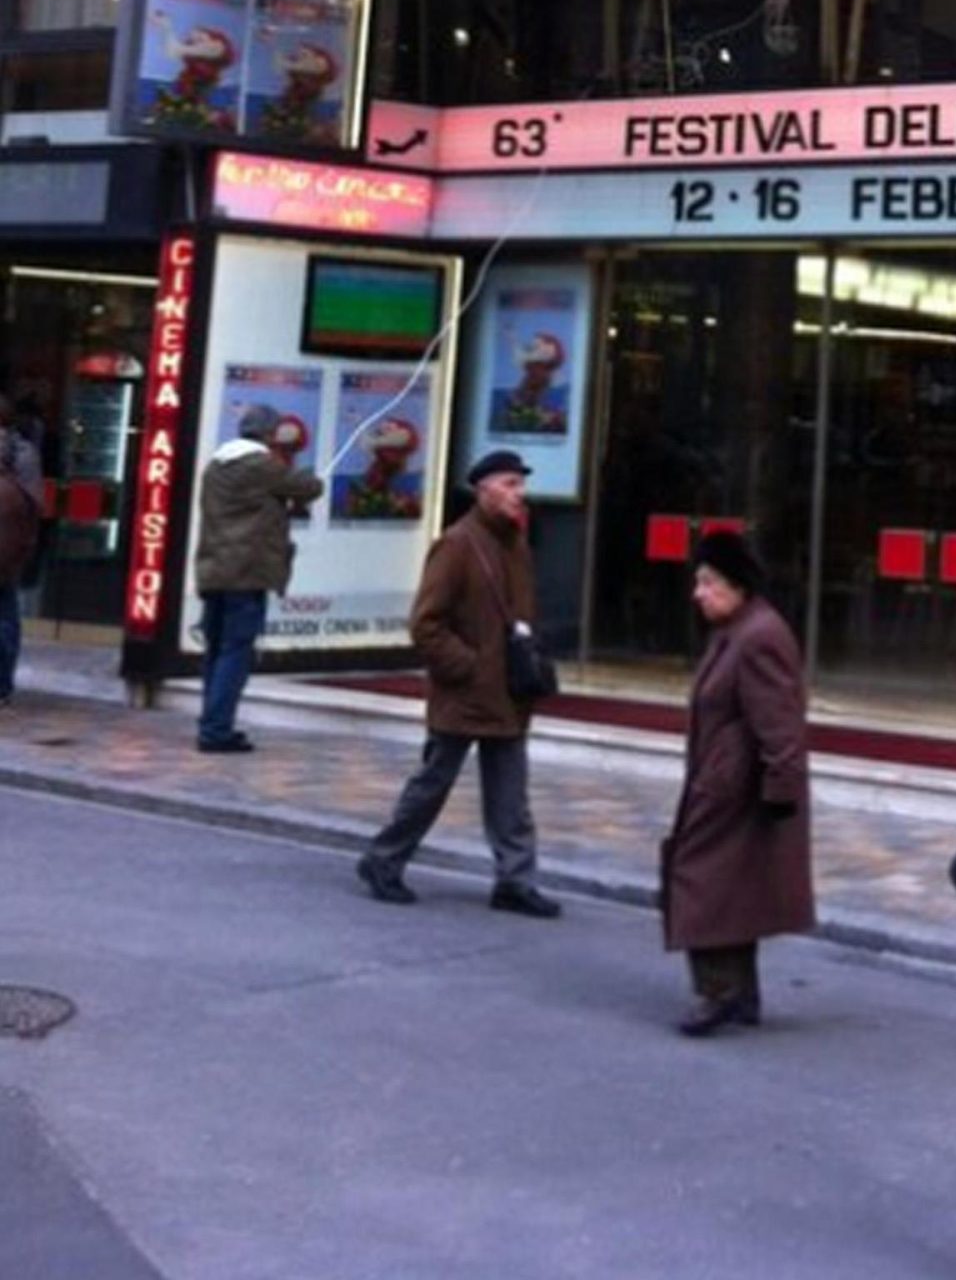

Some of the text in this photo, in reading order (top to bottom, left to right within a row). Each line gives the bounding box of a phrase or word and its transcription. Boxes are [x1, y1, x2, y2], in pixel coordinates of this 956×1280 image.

[622, 109, 836, 157] FESTIVAL
[131, 238, 195, 621] CINEMA ARISTON
